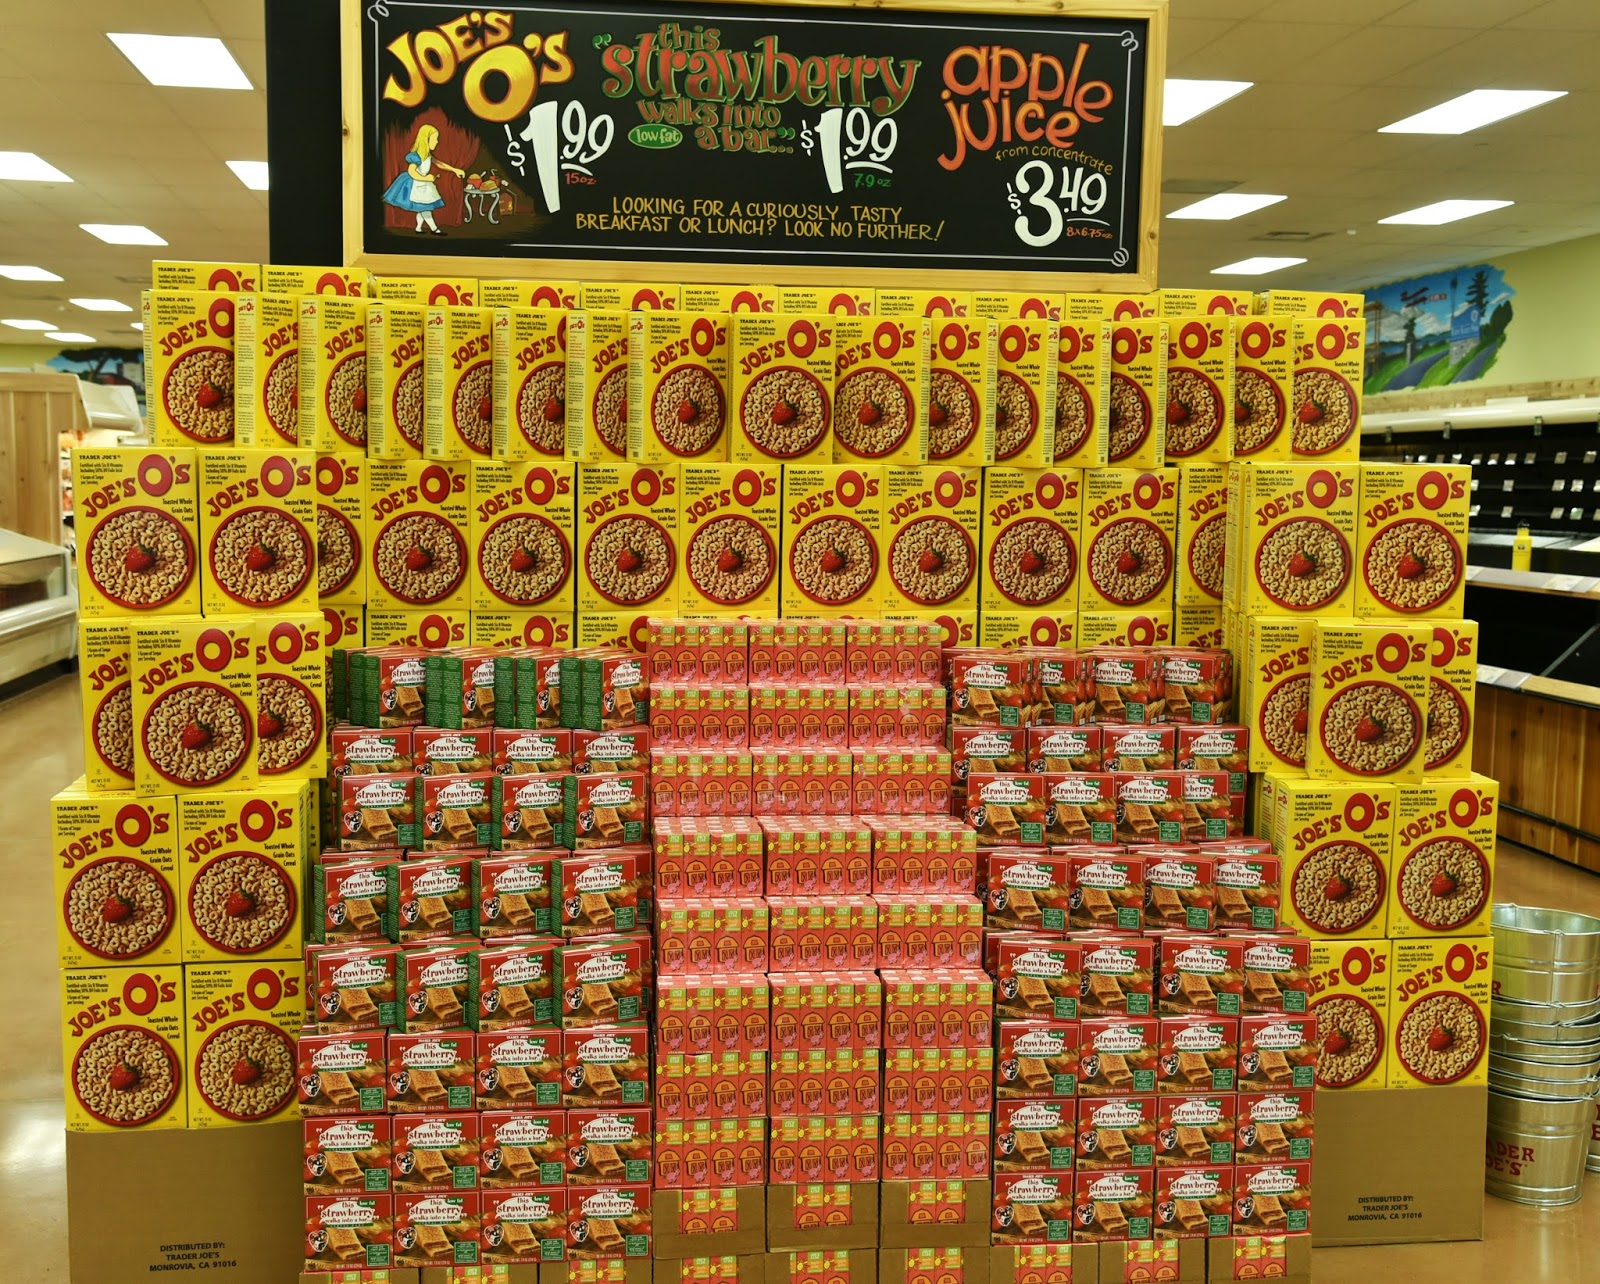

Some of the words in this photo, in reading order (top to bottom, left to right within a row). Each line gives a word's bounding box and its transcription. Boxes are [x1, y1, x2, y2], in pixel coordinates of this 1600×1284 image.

[658, 22, 721, 51] this
[383, 10, 513, 108] JOE'S
[942, 42, 1114, 123] apple
[636, 99, 719, 127] walks
[723, 101, 781, 127] into
[637, 129, 658, 143] low
[659, 128, 679, 143] fat
[695, 126, 720, 149] a
[937, 88, 1080, 171] juice
[996, 144, 1029, 162] from
[1031, 147, 1114, 176] concentrate
[854, 173, 875, 188] 7.9
[613, 197, 685, 215] LOOKING
[693, 200, 724, 217] FOR
[729, 201, 742, 217] A
[747, 202, 839, 221] CURIOUSLY
[850, 206, 902, 224] TASTY
[576, 213, 672, 232] BREAKFAST
[679, 217, 701, 233] OR
[708, 218, 777, 235] LUNCH?
[785, 219, 824, 238] LOOK
[830, 221, 853, 238] NO
[857, 219, 945, 242] FURTHER!
[650, 338, 690, 374] JOE'S
[740, 340, 786, 375] JOE'S
[82, 478, 136, 518] JOE'S
[207, 478, 259, 517] JOE'S
[372, 485, 418, 521] JOE'S
[476, 487, 523, 523] JOE'S
[583, 488, 630, 524] JOE'S
[685, 489, 731, 524] JOE'S
[789, 490, 834, 525] JOE'S
[889, 491, 932, 525] JOE'S
[990, 492, 1034, 527] JOE'S
[1089, 493, 1132, 526] JOE'S
[1256, 491, 1304, 526] JOE'S
[1364, 492, 1414, 528] JOE'S
[138, 653, 194, 695] JOE'S
[1322, 654, 1374, 689] JOE'S
[428, 744, 475, 754] strawberry
[966, 741, 1010, 750] strawberry
[438, 791, 484, 800] strawberry
[185, 823, 239, 863] JOE'S
[1294, 814, 1342, 851] JOE'S
[1399, 810, 1447, 846] JOE'S
[59, 828, 114, 869] JOE'S
[414, 877, 459, 887] strawberry
[576, 874, 621, 884] strawberry
[1004, 871, 1051, 883] strawberry
[334, 968, 385, 978] strawberry
[1176, 956, 1227, 968] strawberry
[1397, 965, 1443, 1002] JOE'S
[68, 997, 122, 1037] JOE'S
[192, 992, 245, 1032] JOE'S
[314, 1051, 367, 1061] strawberry
[492, 1047, 544, 1057] strawberry
[1094, 1036, 1143, 1045] strawberry
[409, 1206, 463, 1216] strawberry
[1358, 1196, 1401, 1204] DISTRIBUTED
[1363, 1204, 1389, 1212] TRADER
[1348, 1213, 1387, 1221] MONROVIA,
[160, 1243, 212, 1252] DISTRIBUTED
[166, 1253, 198, 1261] TRADER
[150, 1263, 195, 1272] MONROVIA,
[213, 1260, 237, 1268] 91016
